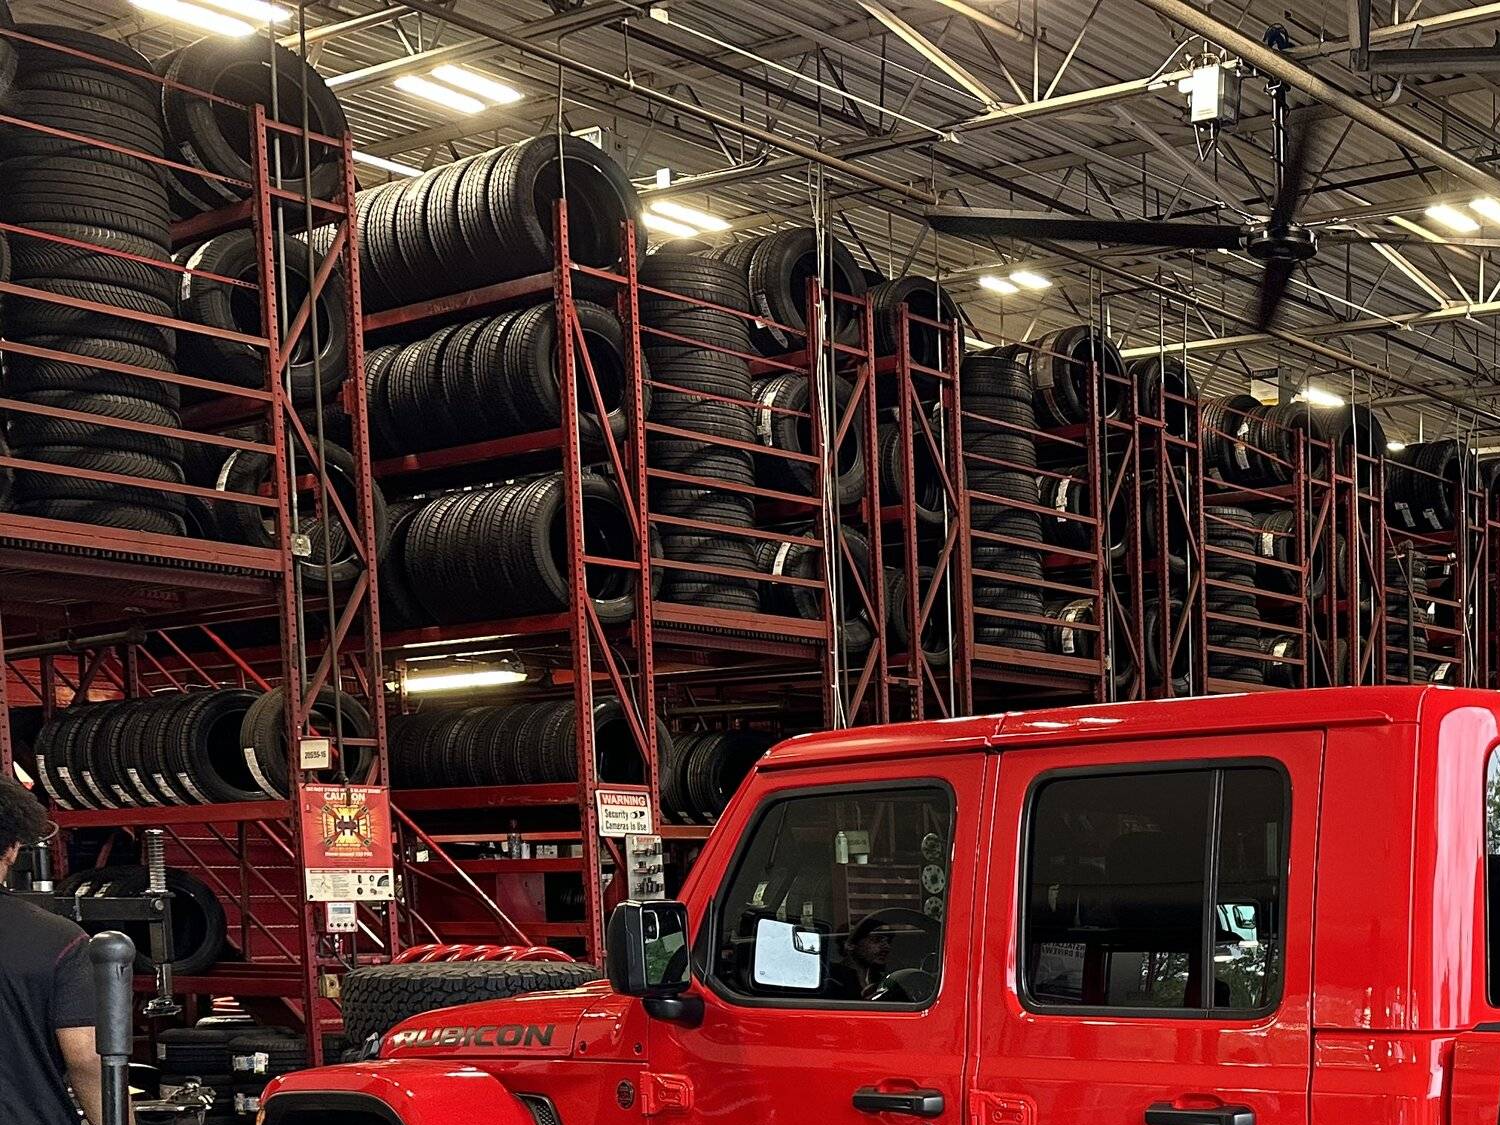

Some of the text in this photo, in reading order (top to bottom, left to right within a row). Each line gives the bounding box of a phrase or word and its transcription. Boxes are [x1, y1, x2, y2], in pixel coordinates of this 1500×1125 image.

[323, 792, 366, 802] CAUTON
[601, 793, 646, 807] WARNING
[604, 808, 628, 821] Security
[605, 820, 629, 831] Cameras
[391, 1024, 556, 1049] RUBICON
